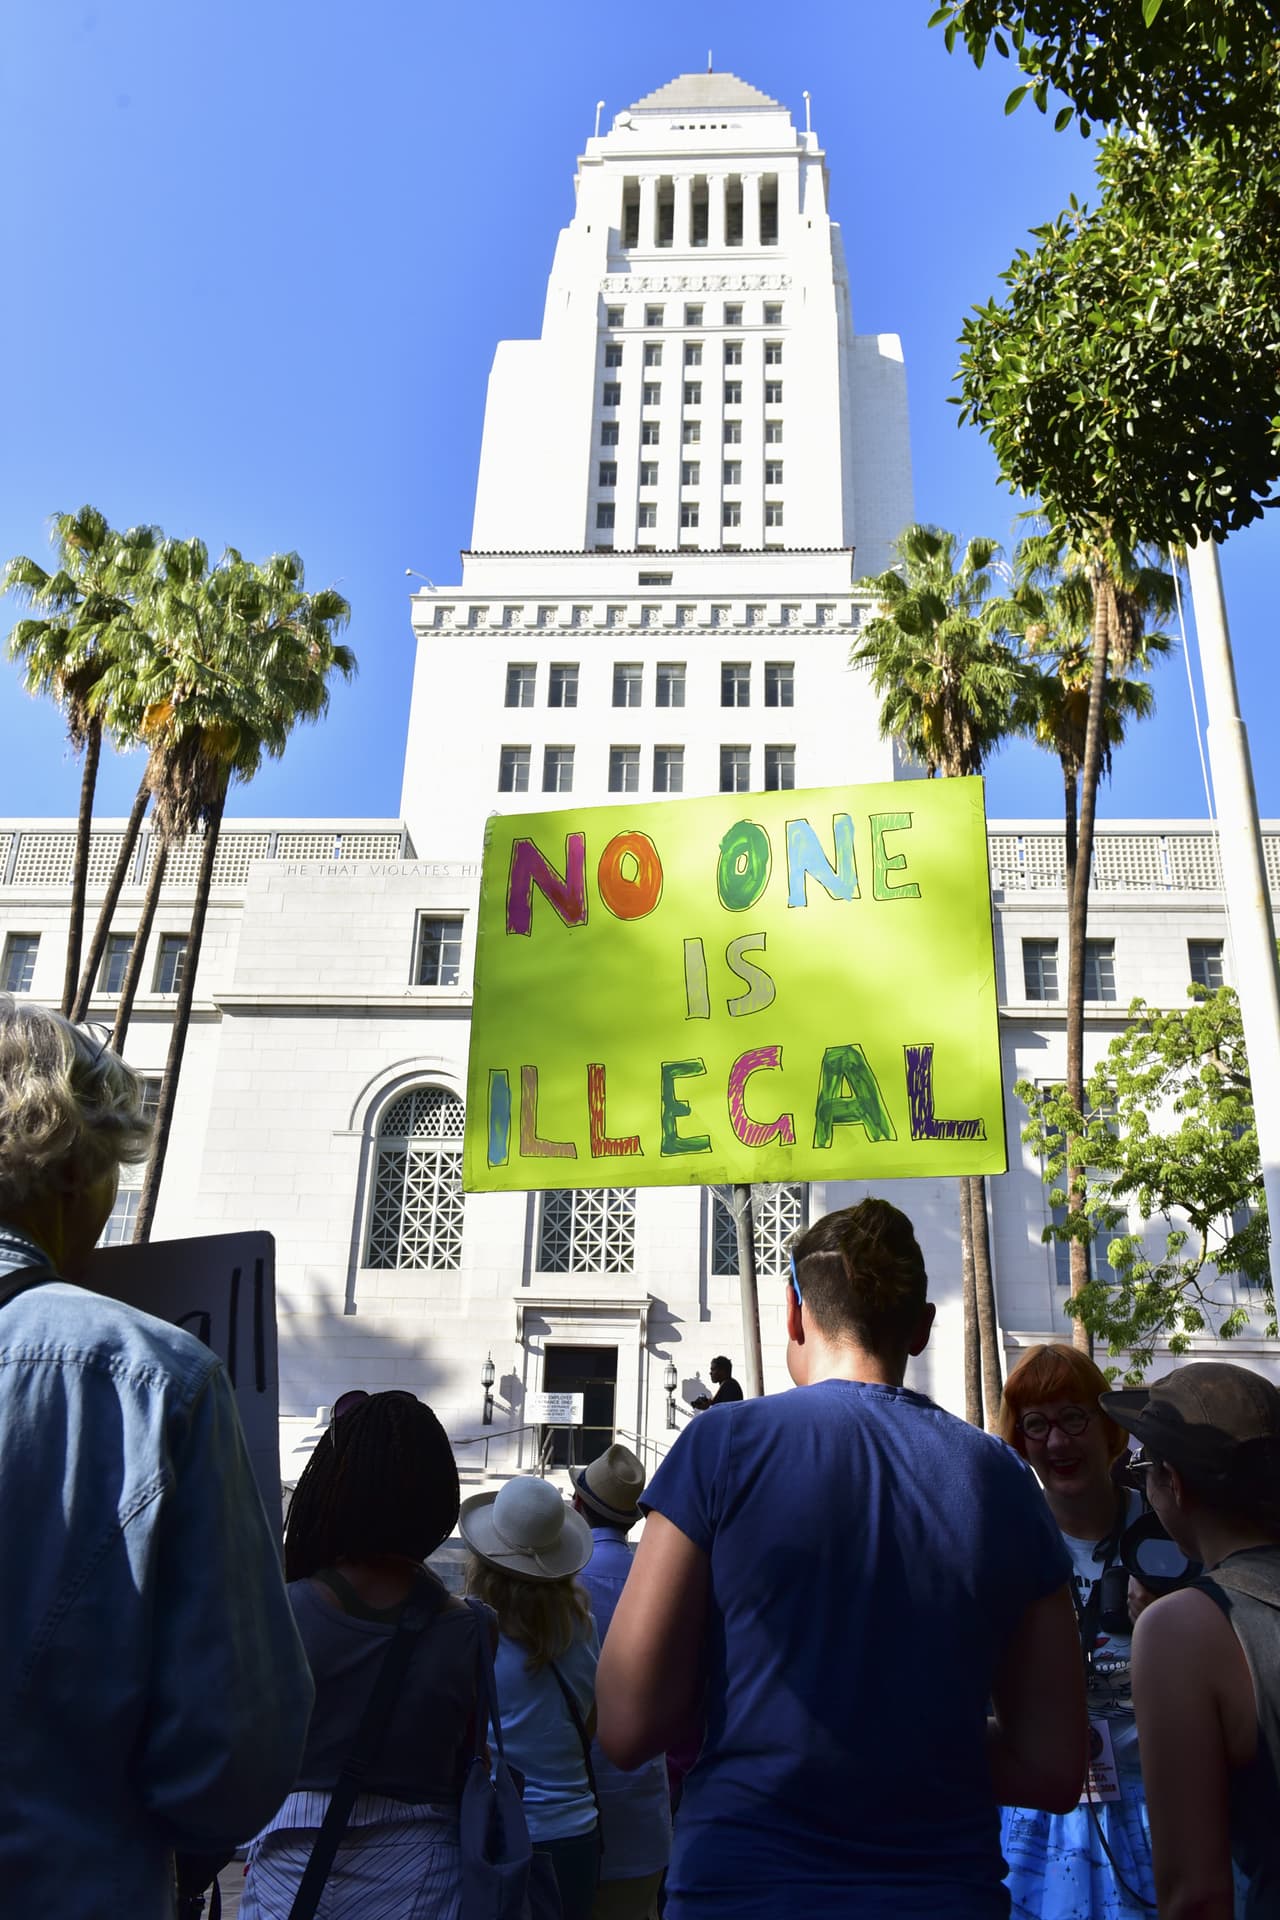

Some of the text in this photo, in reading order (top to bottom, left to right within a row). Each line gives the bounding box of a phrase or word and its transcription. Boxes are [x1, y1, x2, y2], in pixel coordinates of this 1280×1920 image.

[319, 864, 359, 876] THAT
[369, 864, 450, 876] VIOLATES
[462, 864, 478, 876] HI
[506, 812, 922, 937] NO ONE
[684, 932, 776, 1020] IS
[487, 1043, 987, 1167] ILLEGAL
